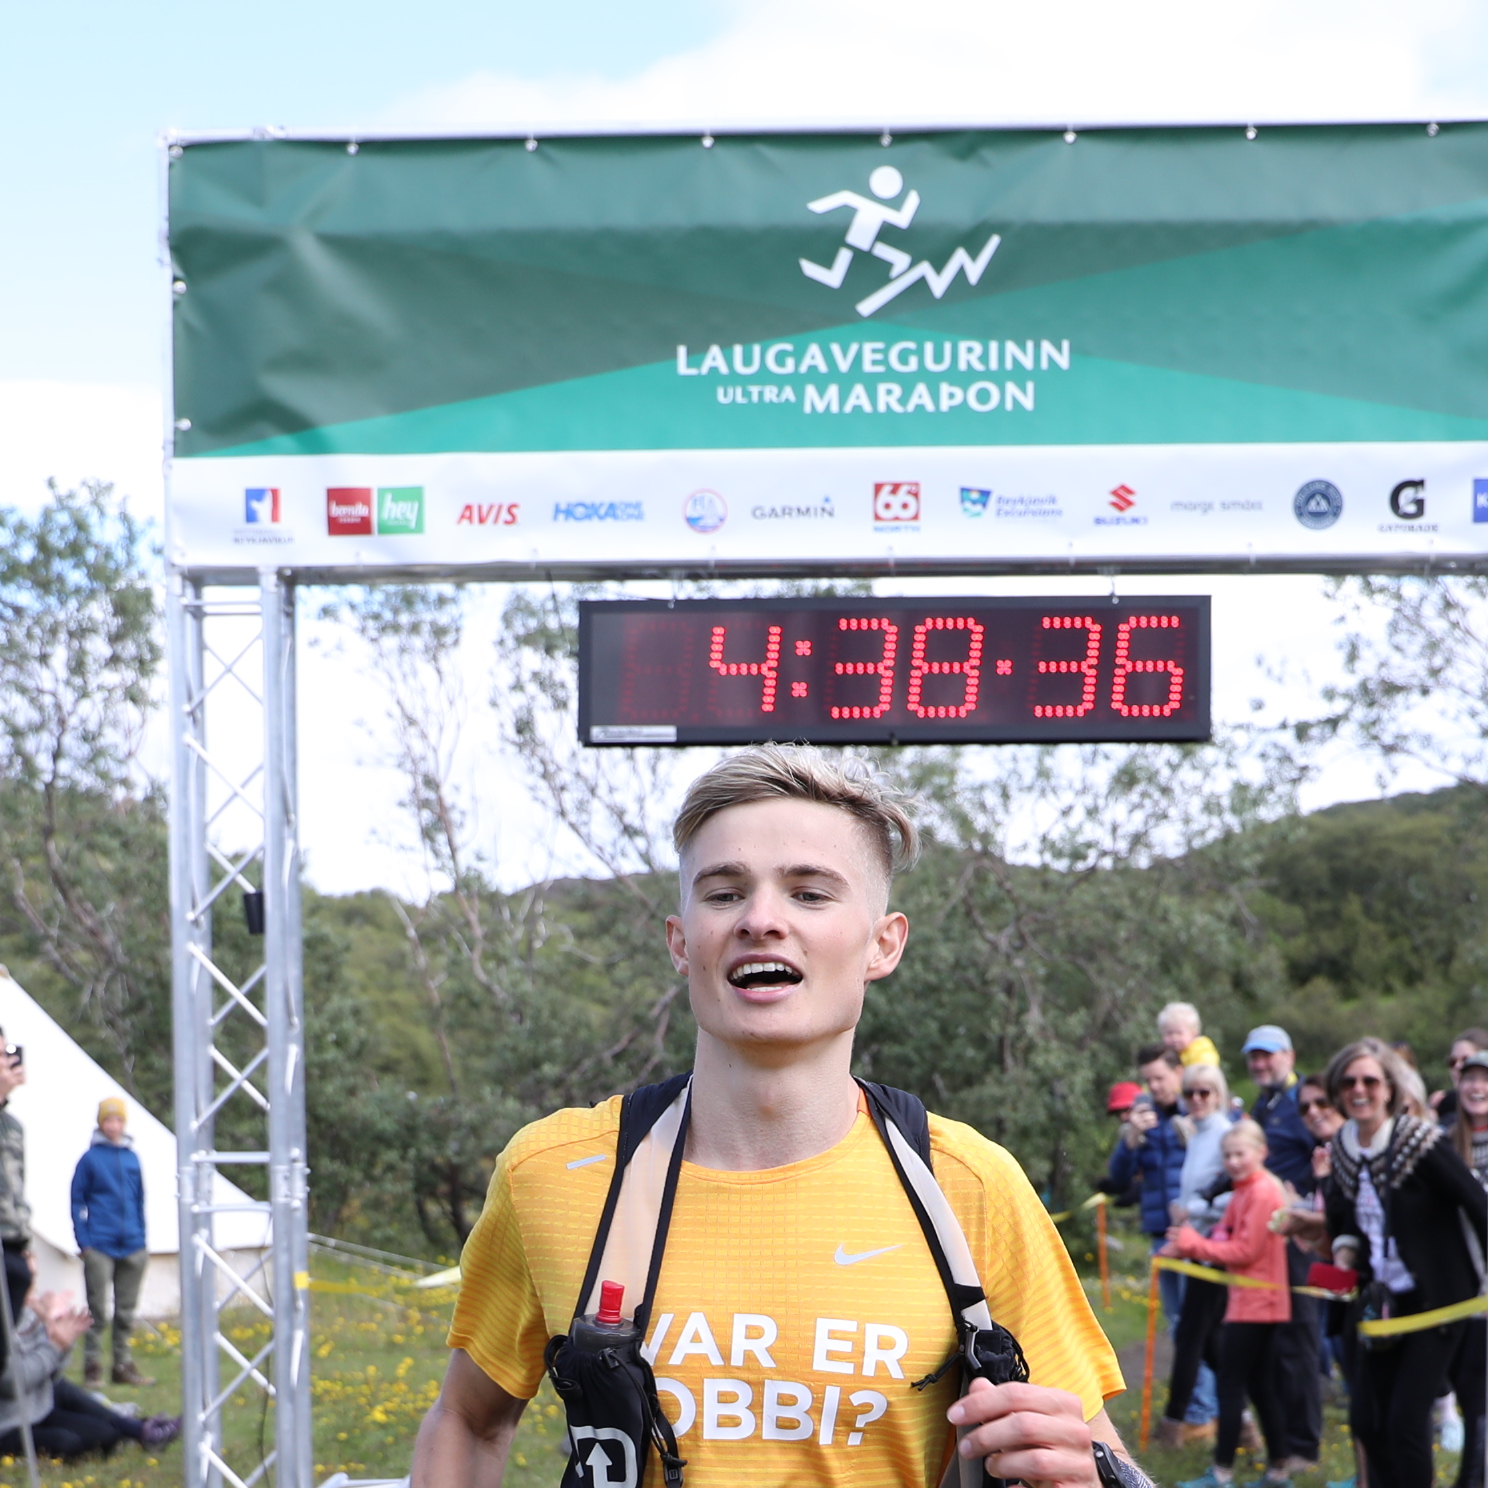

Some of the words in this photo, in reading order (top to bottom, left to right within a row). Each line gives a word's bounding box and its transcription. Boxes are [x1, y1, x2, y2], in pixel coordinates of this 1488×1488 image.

[676, 340, 1071, 376] LAUGAVEGURINN
[716, 385, 796, 404] ULTRA
[802, 381, 1035, 414] MARAÞON
[381, 492, 420, 530] hey
[457, 503, 520, 525] AVIS
[552, 502, 618, 522] HOKA
[751, 505, 836, 520] GARMIN
[640, 1311, 777, 1368] VAR
[812, 1317, 909, 1379] ER
[652, 1377, 888, 1446] OBBI?
